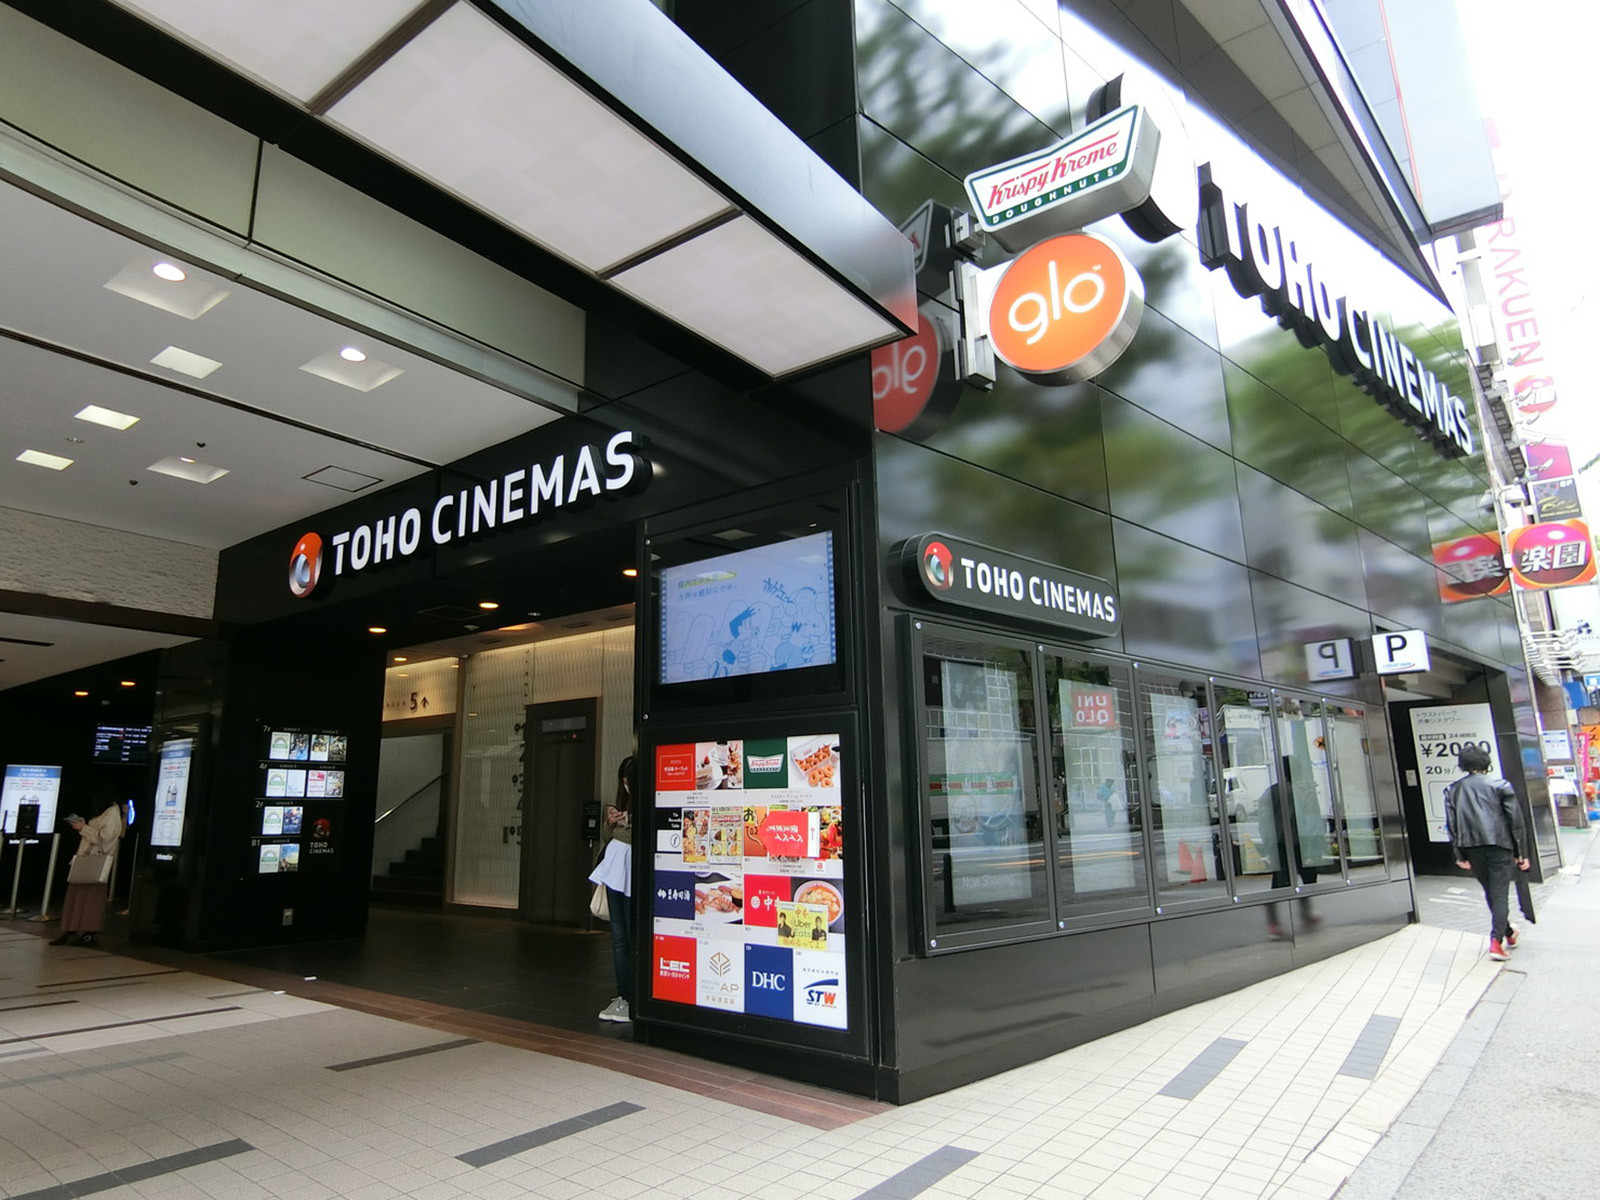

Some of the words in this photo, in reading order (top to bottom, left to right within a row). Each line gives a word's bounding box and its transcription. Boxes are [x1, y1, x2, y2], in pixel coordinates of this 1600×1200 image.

[986, 160, 1052, 210] Krispy
[1050, 130, 1120, 183] Kreme
[992, 167, 1115, 224] DOUGHNUTS
[1008, 260, 1106, 345] glo
[1196, 161, 1347, 352] TOHO
[1349, 308, 1474, 457] CINEMAS
[1485, 216, 1545, 367] RAKUEN
[332, 507, 421, 576] TOHO
[432, 430, 635, 545] CINEMAS
[1520, 541, 1587, 574] 楽園
[961, 558, 1024, 601] TOHO
[1029, 576, 1116, 622] CINEMAS
[1386, 634, 1407, 662] P
[410, 692, 418, 711] 5
[793, 919, 812, 929] Uber
[660, 957, 690, 973] LEC
[720, 982, 739, 993] AP
[752, 971, 785, 991] DHC
